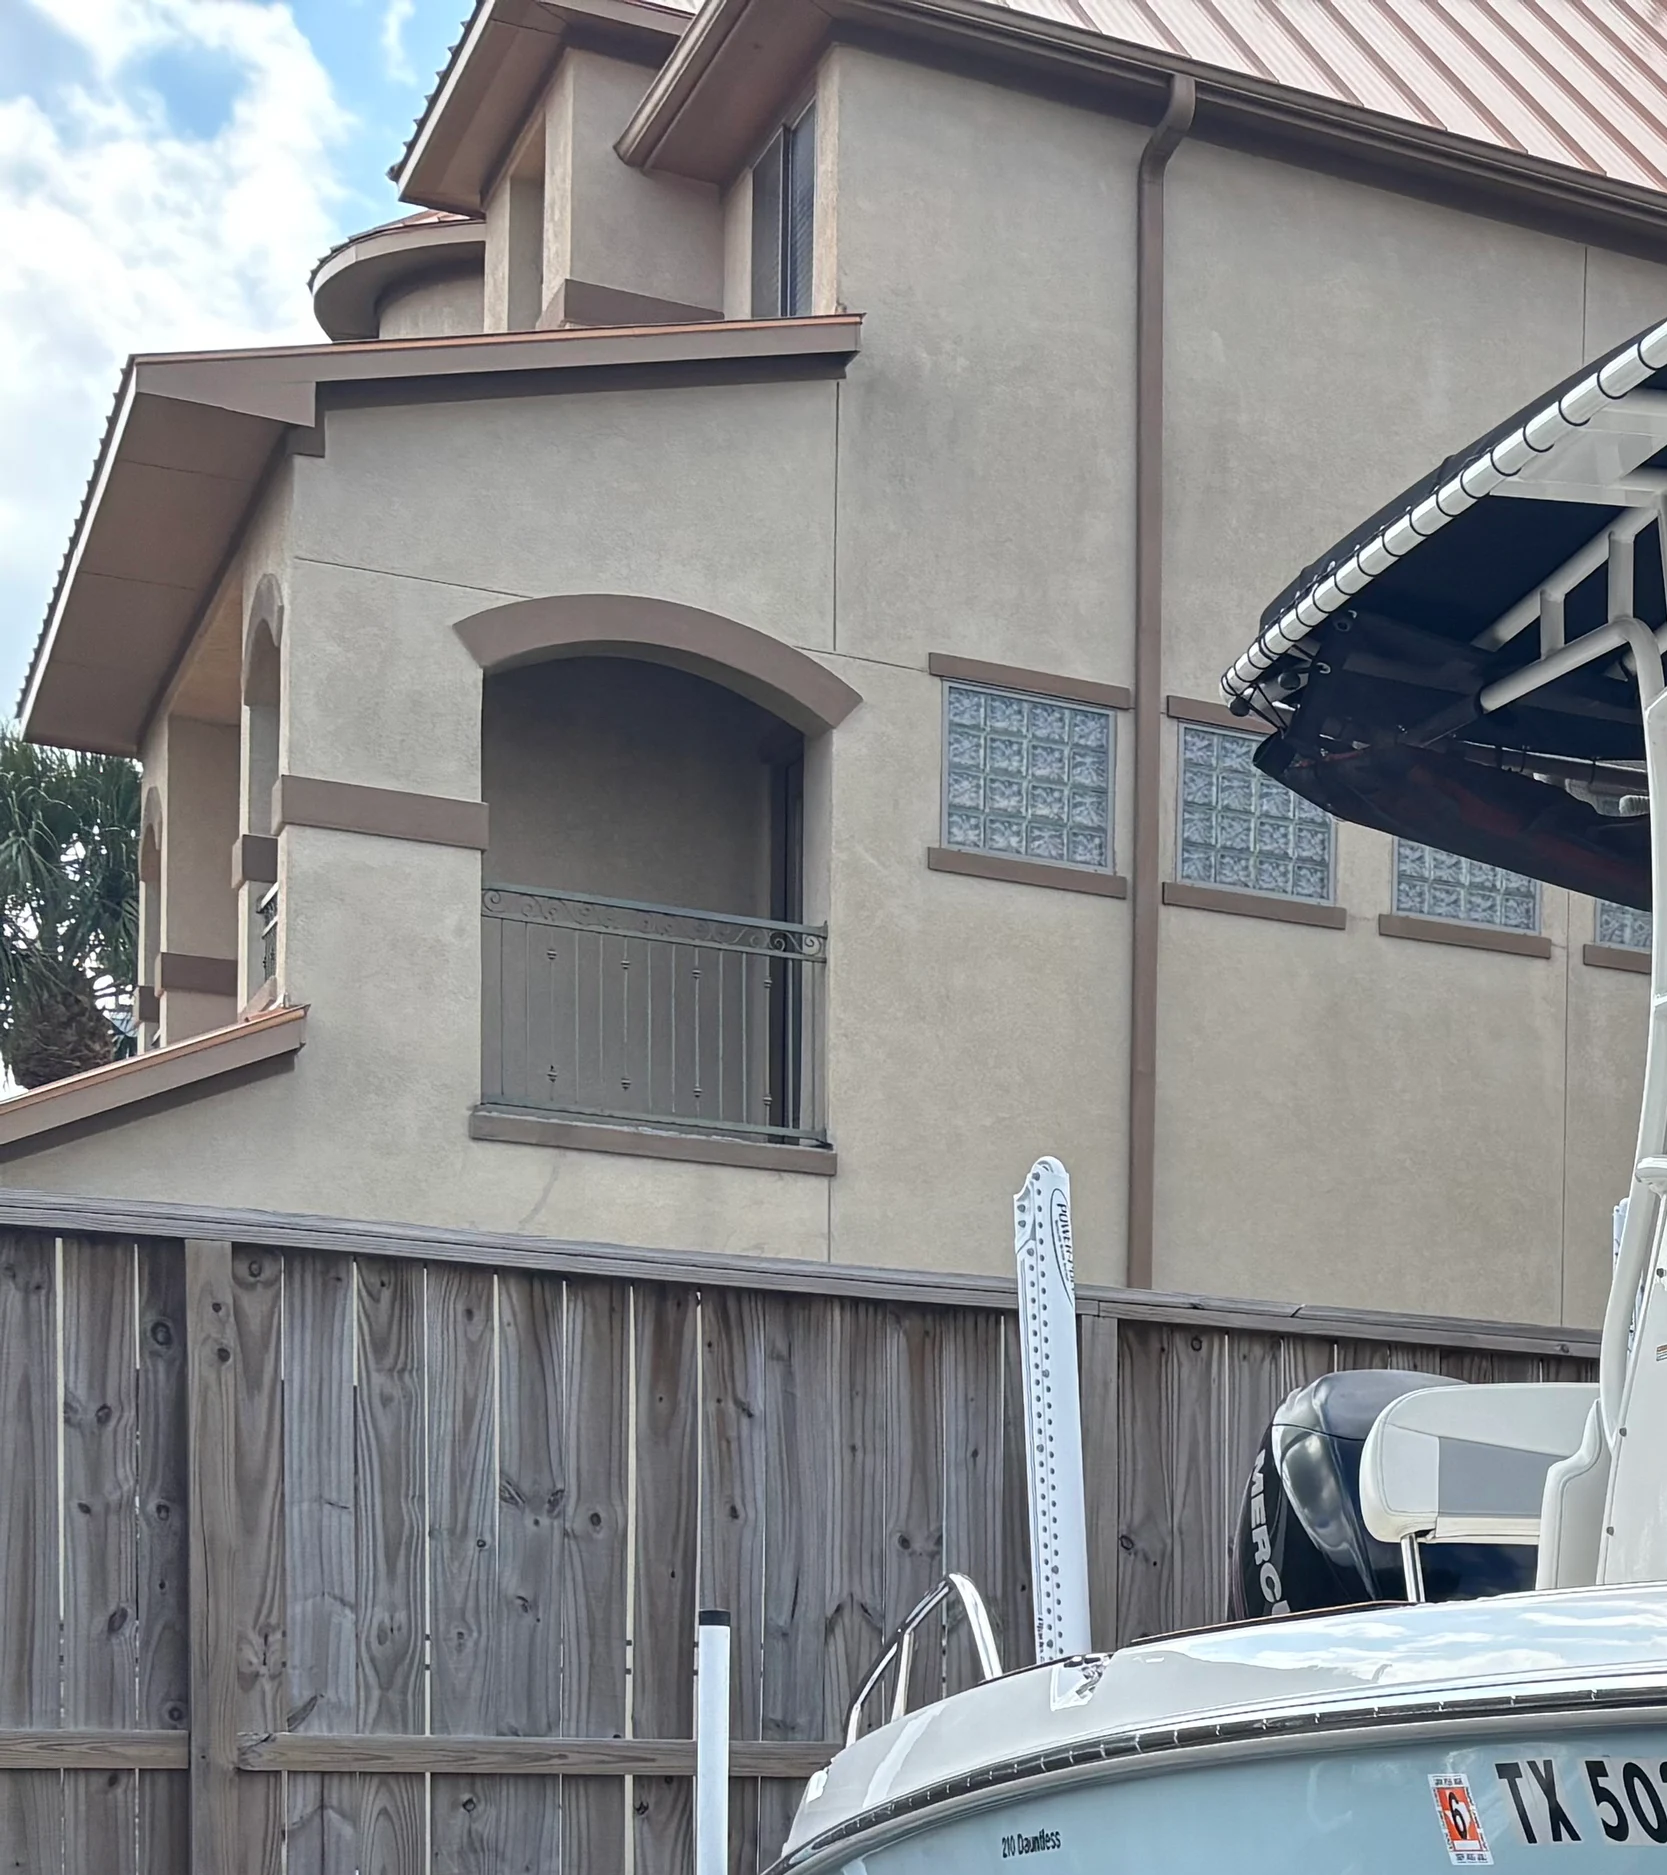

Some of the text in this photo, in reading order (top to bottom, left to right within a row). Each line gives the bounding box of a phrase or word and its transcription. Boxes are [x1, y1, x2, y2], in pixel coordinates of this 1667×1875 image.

[1495, 1759, 1582, 1844] TX
[1001, 1828, 1061, 1858] 210 Dauntless
